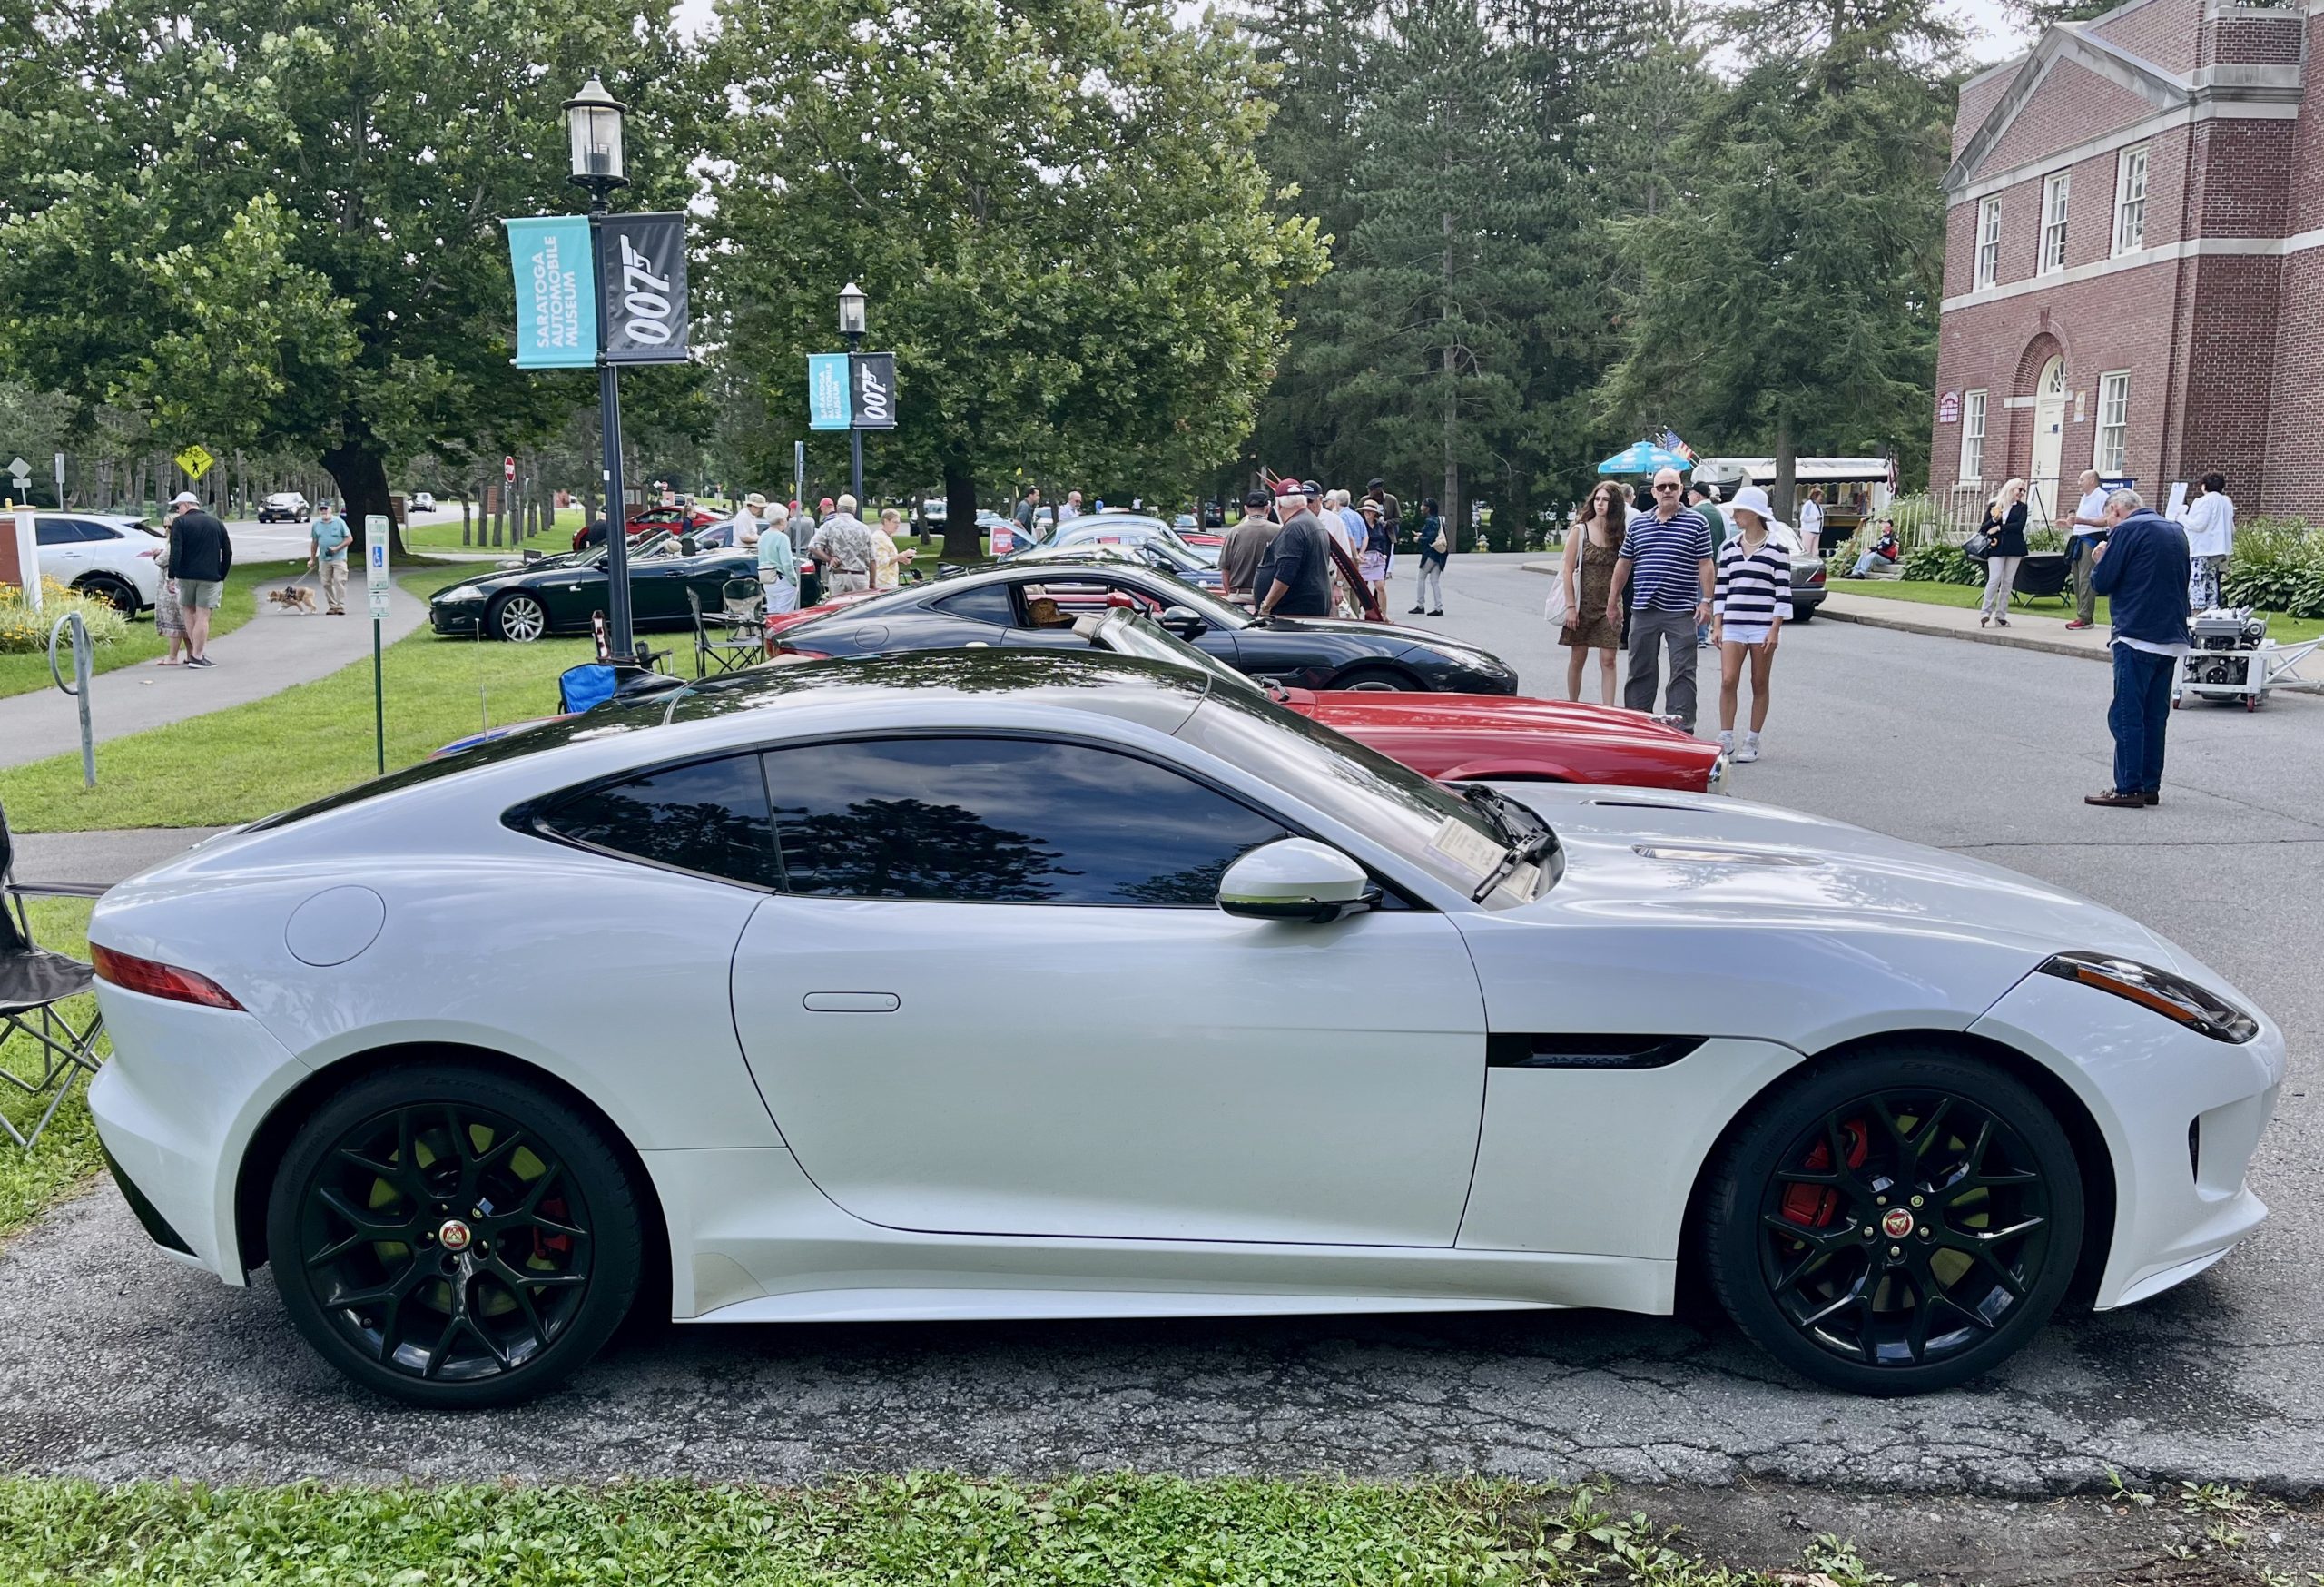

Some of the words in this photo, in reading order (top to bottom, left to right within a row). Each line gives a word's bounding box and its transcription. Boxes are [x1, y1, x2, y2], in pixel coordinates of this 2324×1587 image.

[531, 251, 549, 349] SARATOGA
[544, 235, 564, 348] AUTOMOBILE
[562, 271, 578, 347] MUSEUM
[622, 261, 671, 345] 007
[819, 370, 828, 419] SARATOGA
[833, 380, 842, 419] MUSEUM
[862, 377, 887, 419] 007
